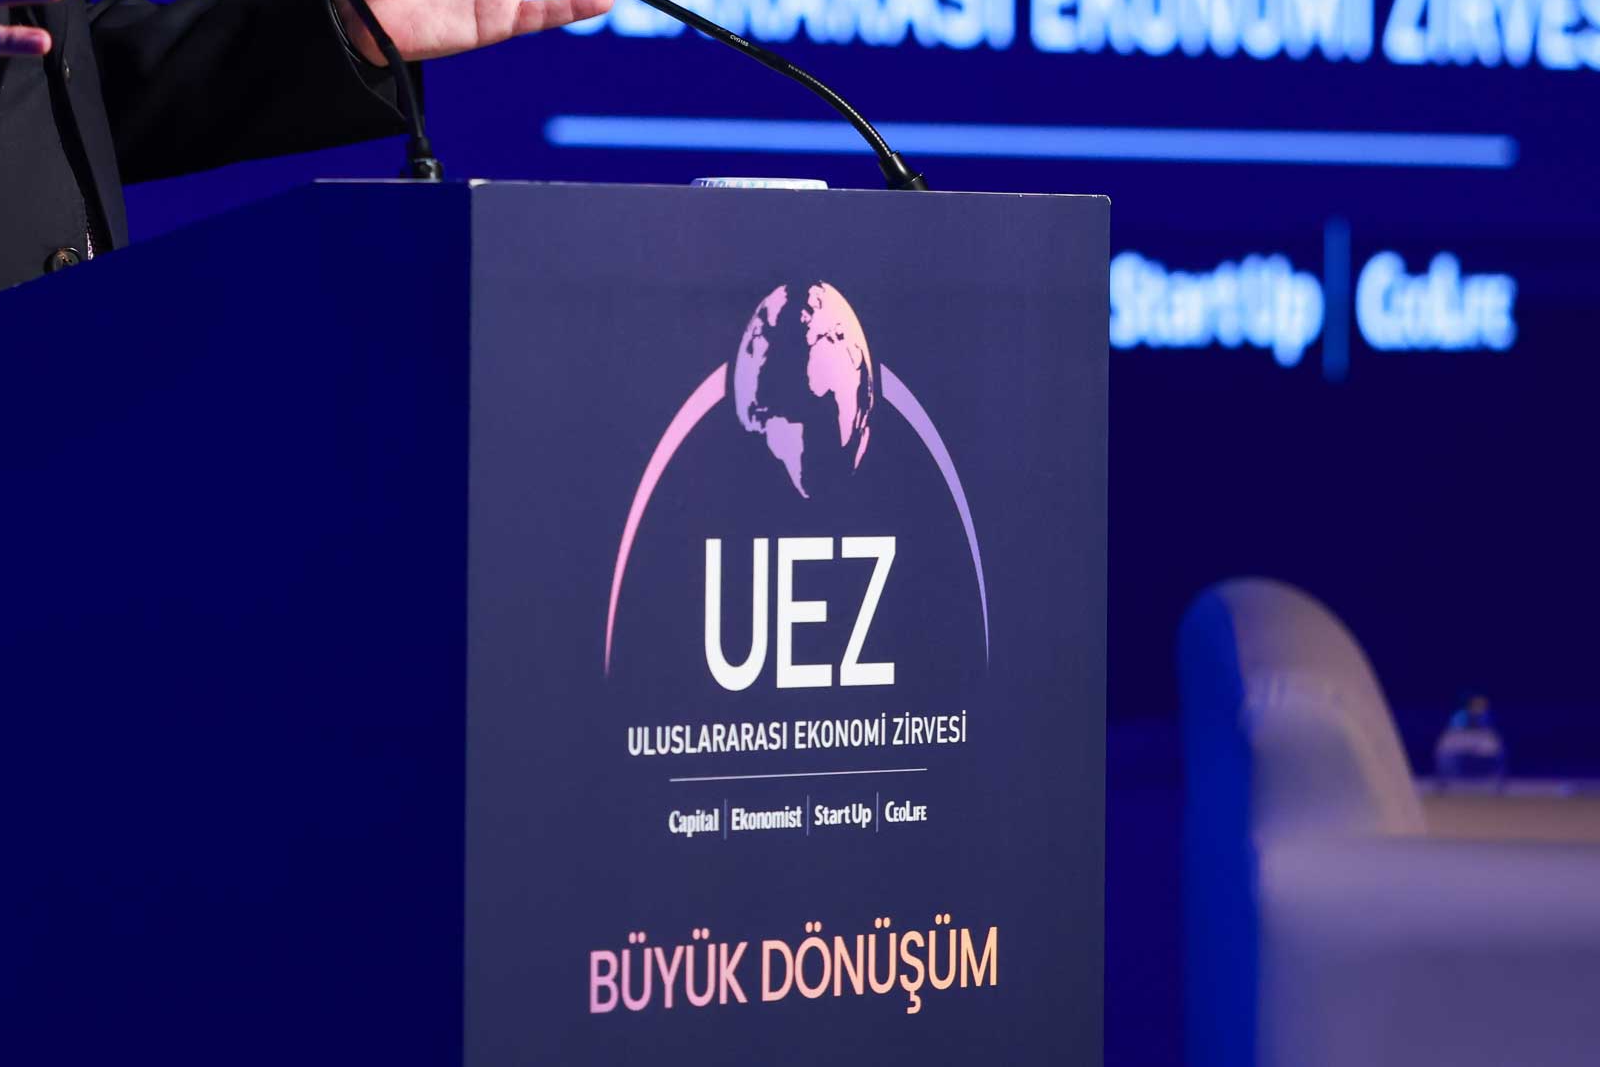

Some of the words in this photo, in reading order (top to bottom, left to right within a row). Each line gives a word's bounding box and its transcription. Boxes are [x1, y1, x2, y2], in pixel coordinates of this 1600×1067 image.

[705, 536, 896, 691] UEZ
[627, 721, 788, 757] ULUSLARARASI
[794, 712, 887, 750] EKONOMİ
[892, 709, 967, 746] ZİRVESİ
[668, 807, 720, 838] Capital
[730, 805, 803, 831] Ekonomist
[589, 927, 749, 1015] BÜYÜK
[761, 913, 998, 1015] DÖNÜŞÜM
